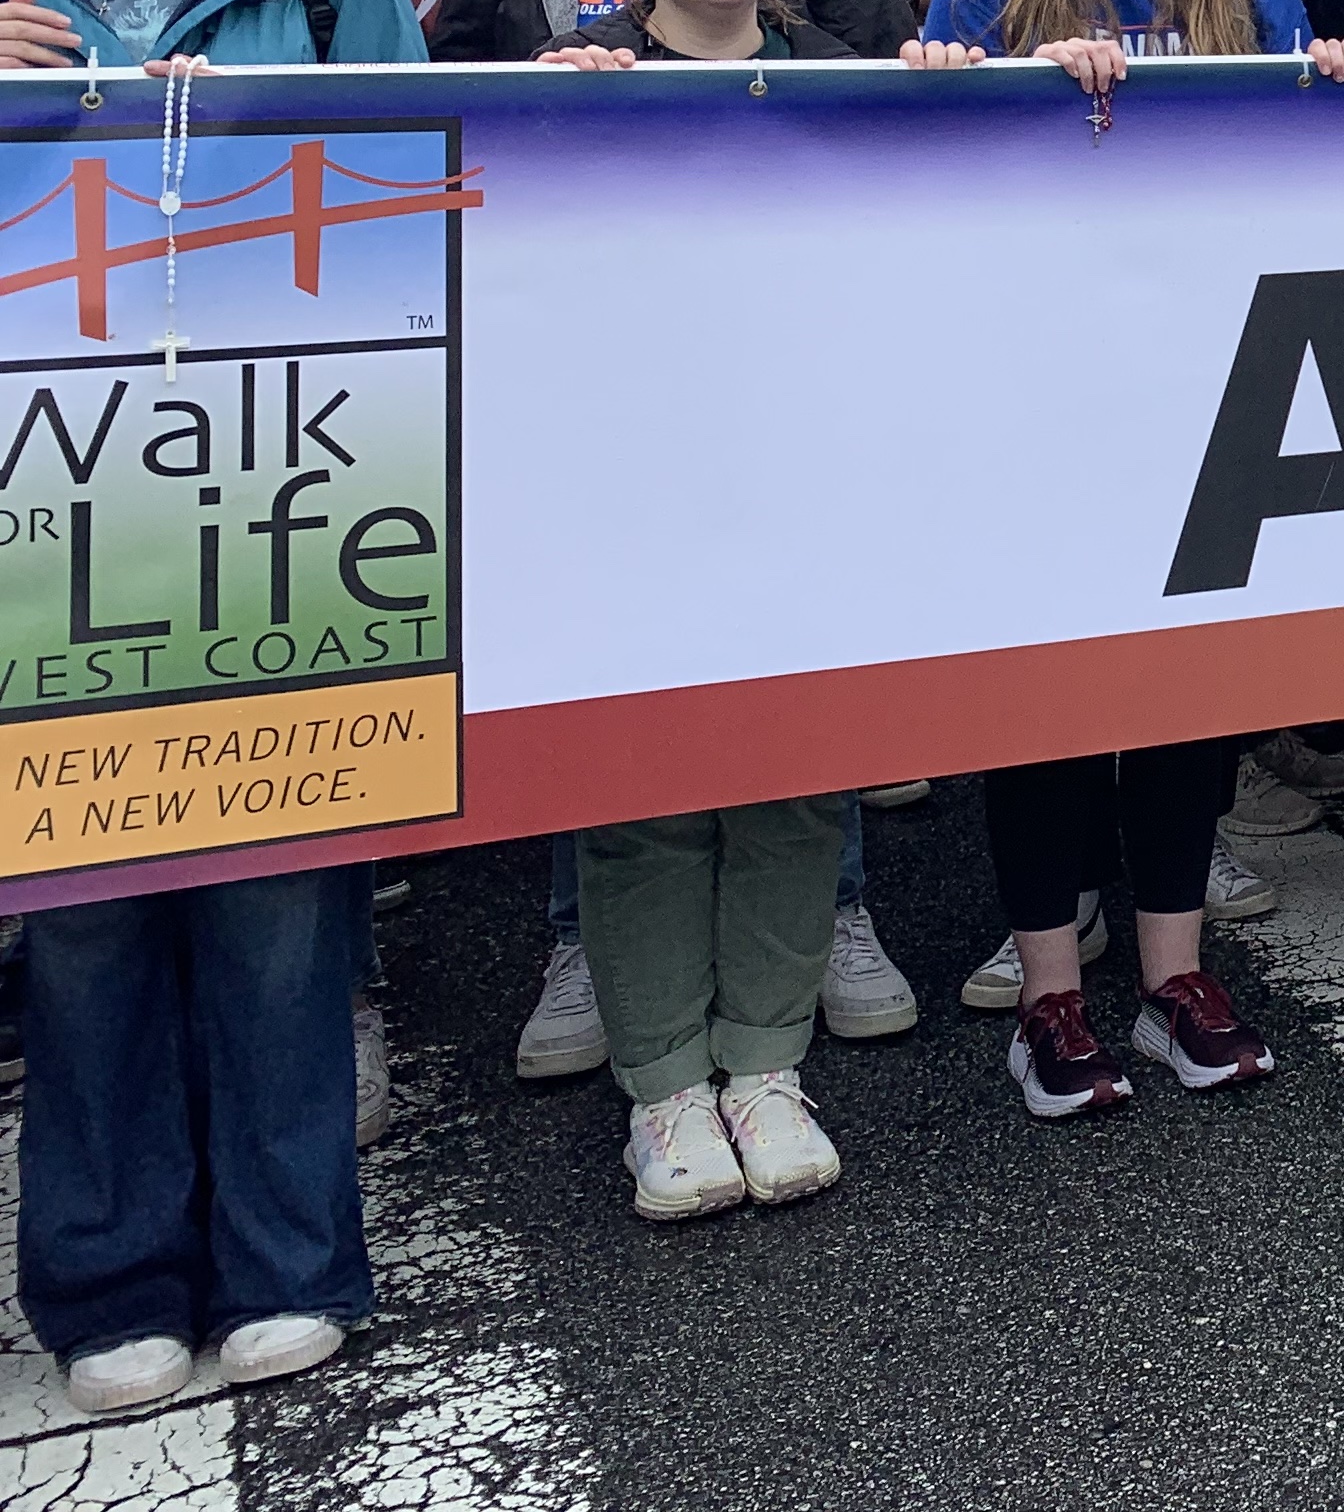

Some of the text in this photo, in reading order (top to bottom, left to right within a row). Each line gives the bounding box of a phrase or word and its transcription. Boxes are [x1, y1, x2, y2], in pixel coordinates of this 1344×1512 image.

[405, 314, 435, 332] TM
[0, 360, 358, 487] Walk
[0, 507, 60, 547] OR
[68, 469, 439, 647] Life
[203, 615, 439, 679] COAST
[15, 707, 428, 793] NEW TRADITION.
[25, 766, 369, 846] A NEW VOICE.
